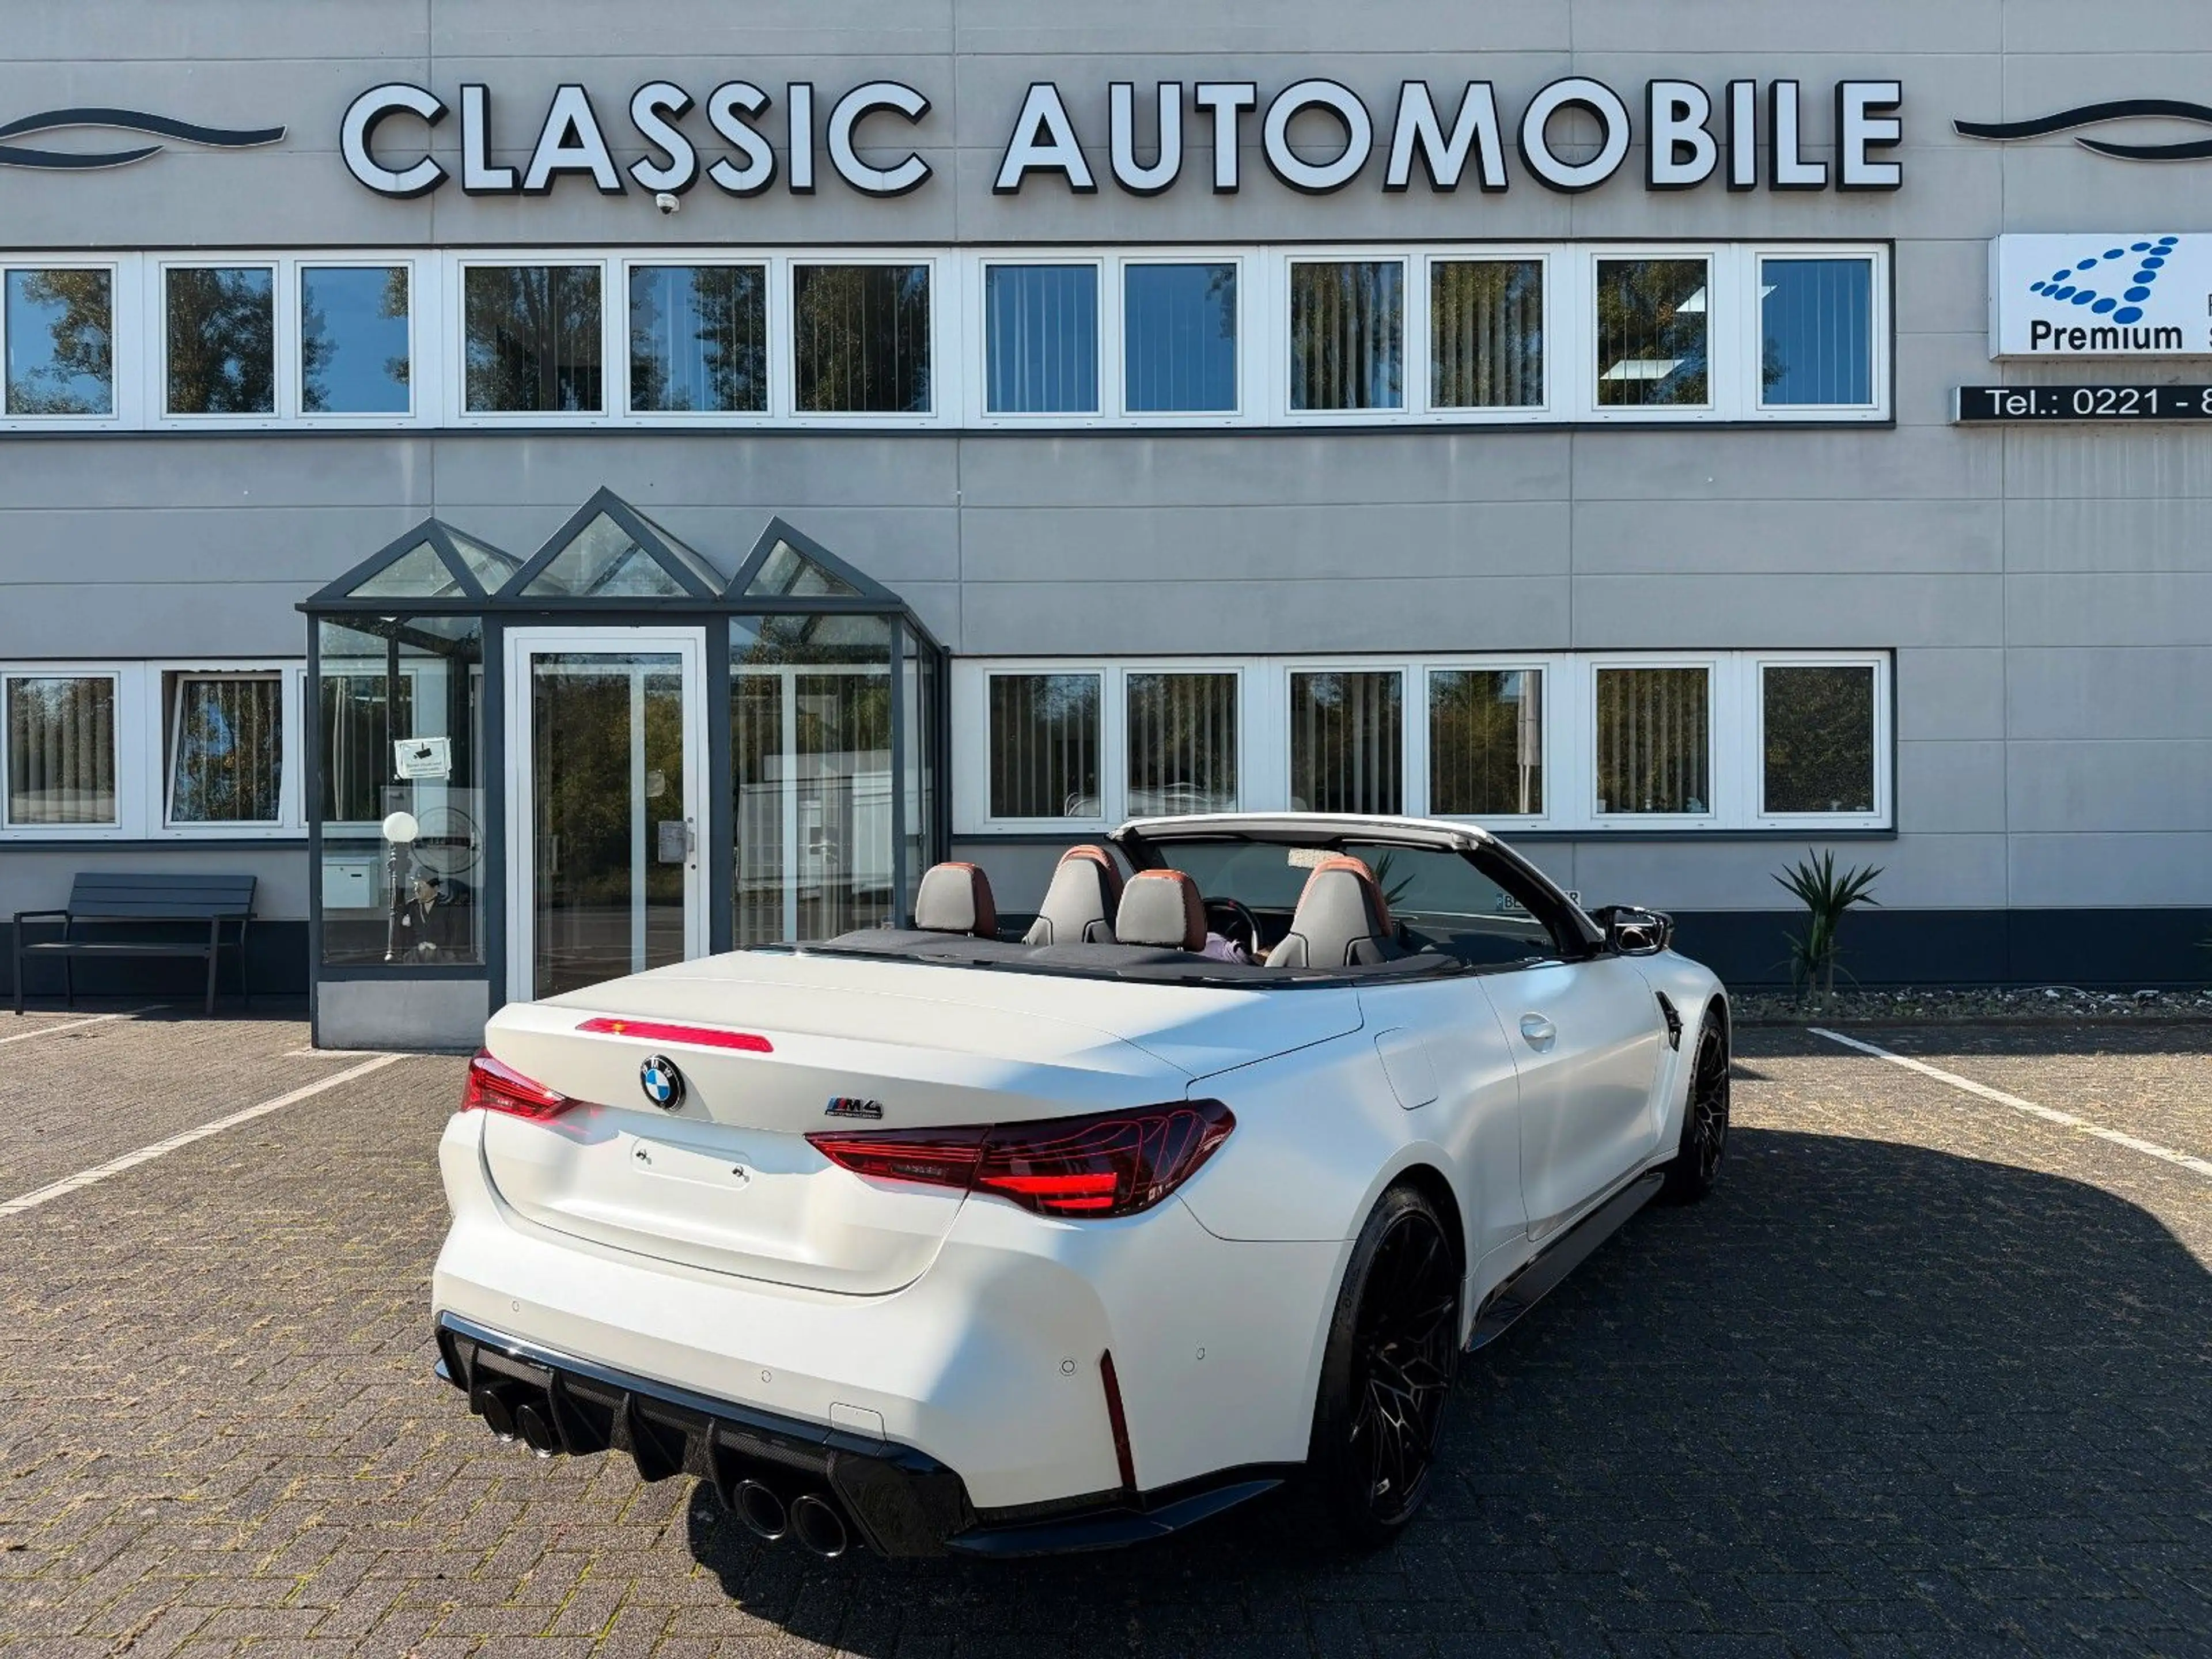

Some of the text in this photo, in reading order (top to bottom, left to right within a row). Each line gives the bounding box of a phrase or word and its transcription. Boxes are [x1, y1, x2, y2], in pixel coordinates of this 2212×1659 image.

[339, 76, 1903, 199] CLASSIC AUTOMOBILE
[2031, 320, 2183, 350] Premium
[1985, 389, 2058, 415] Tel.:
[2073, 388, 2158, 415] 0221
